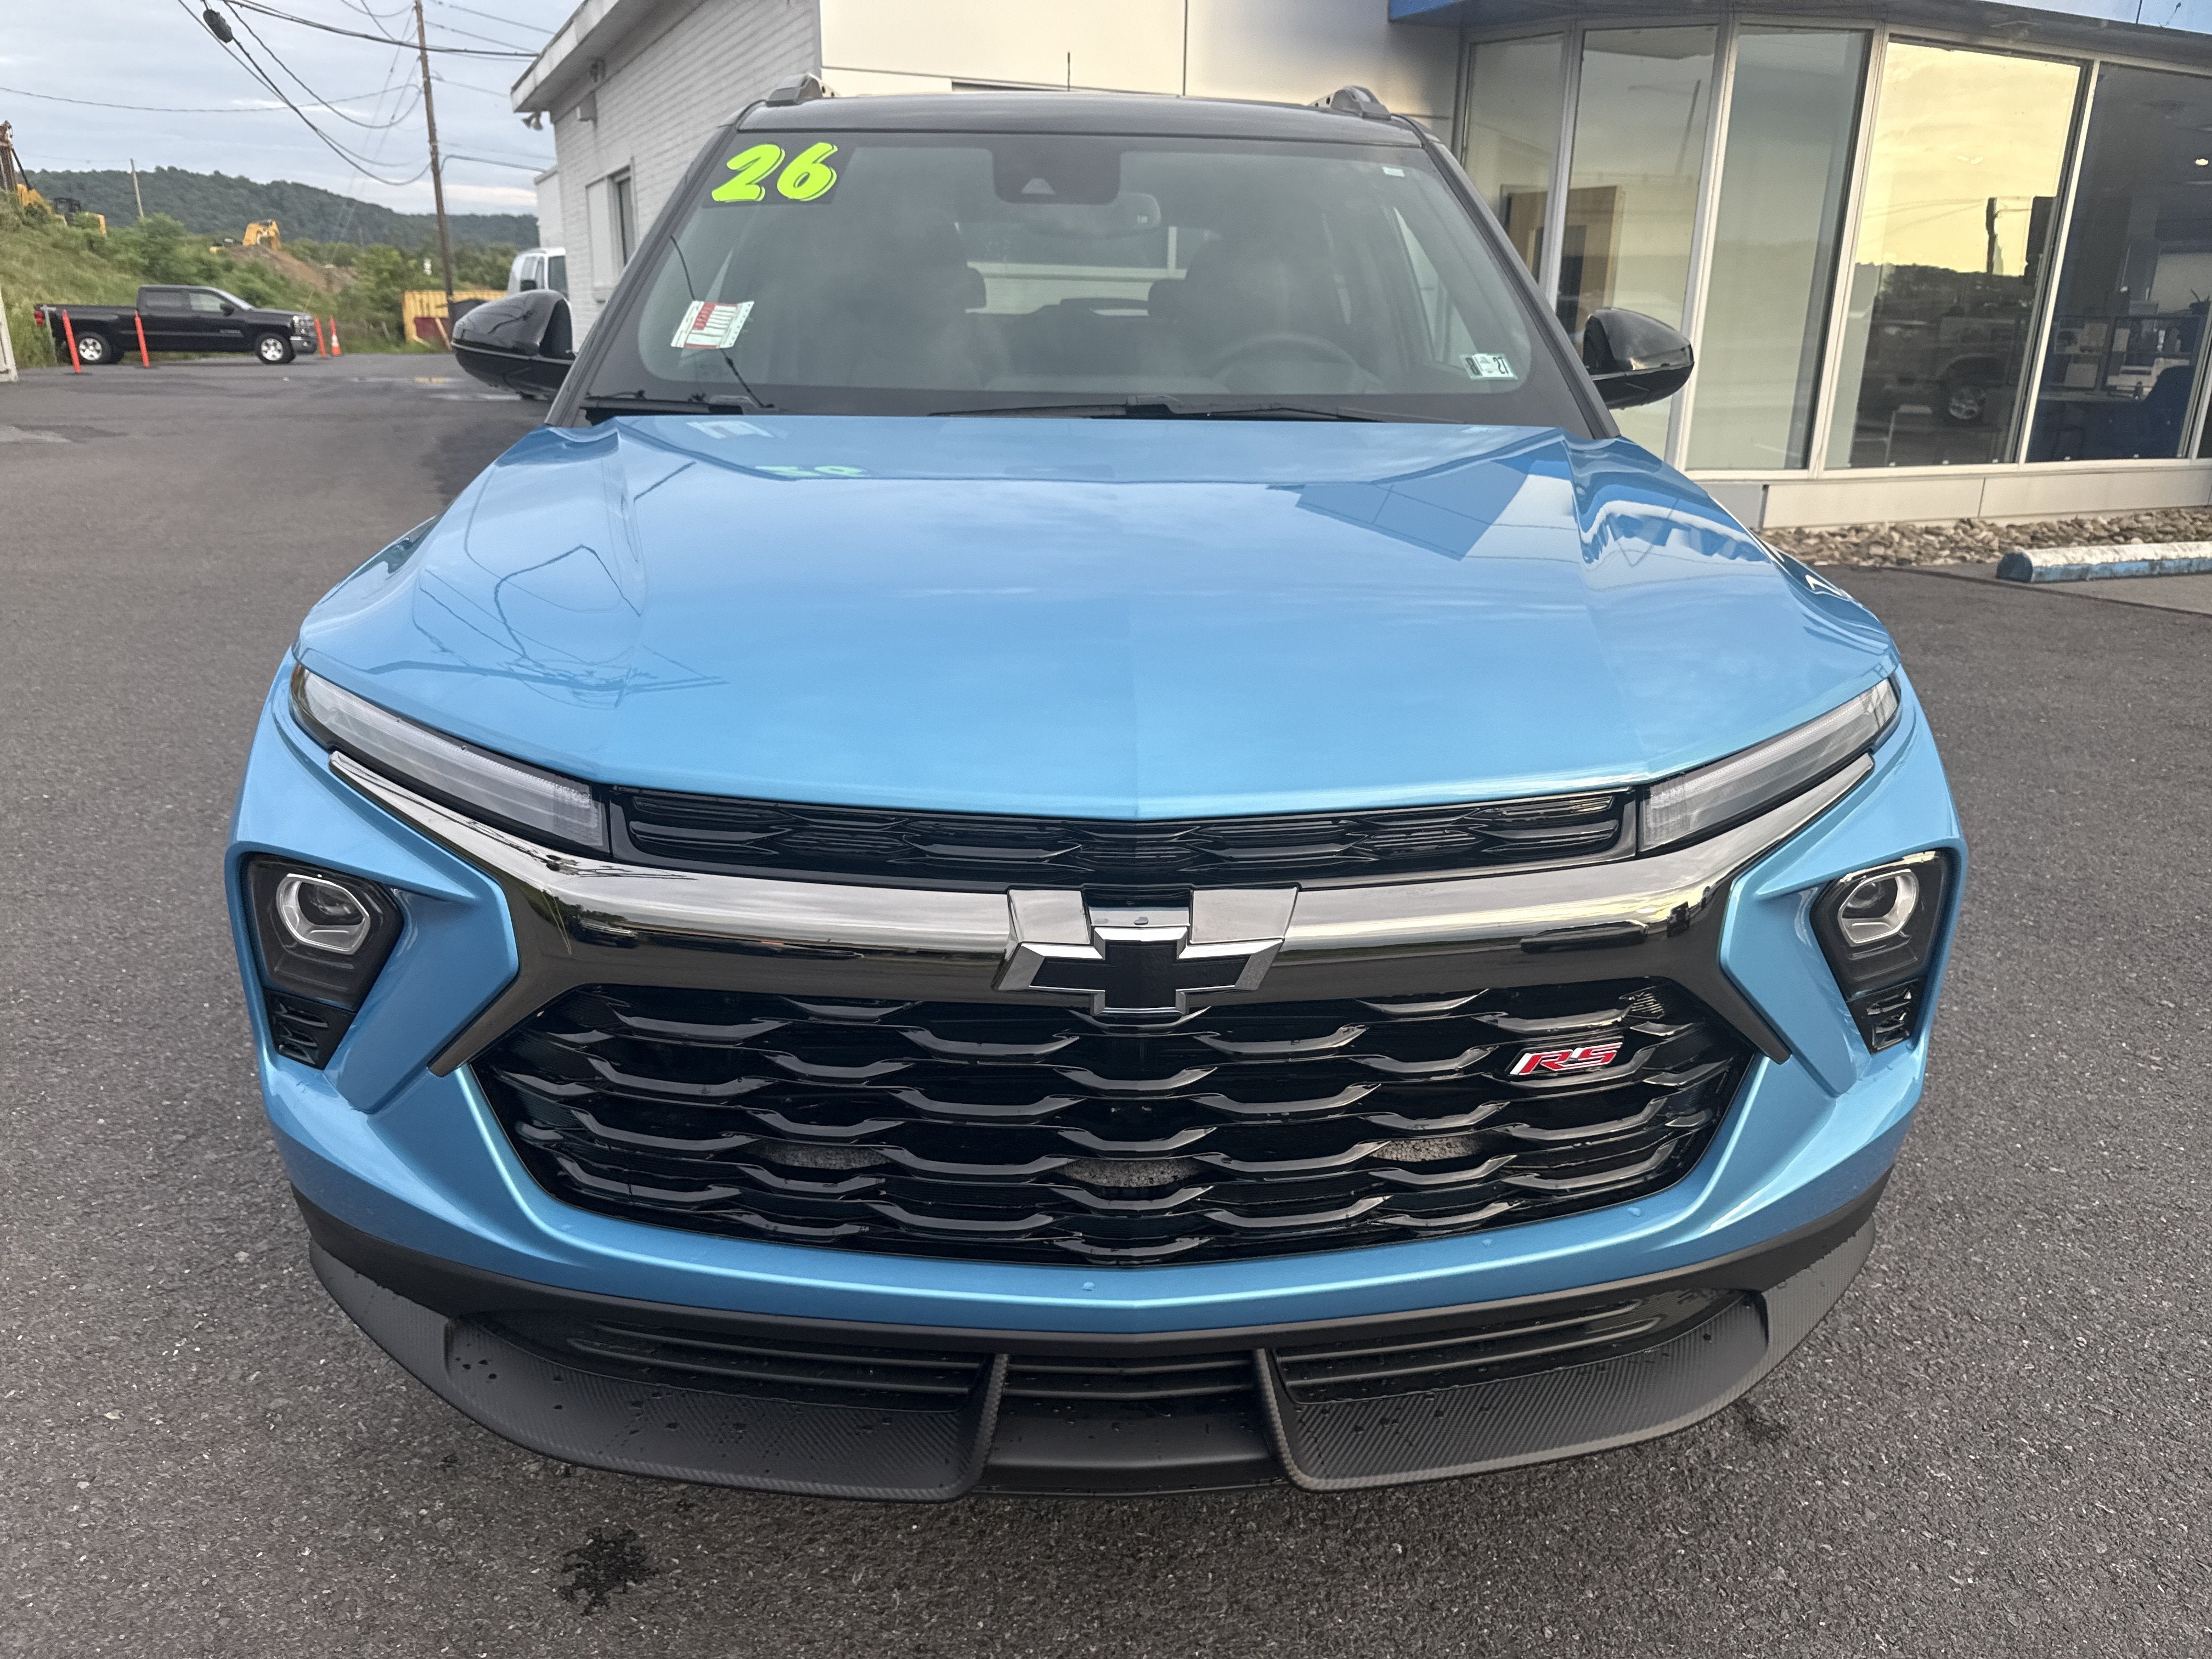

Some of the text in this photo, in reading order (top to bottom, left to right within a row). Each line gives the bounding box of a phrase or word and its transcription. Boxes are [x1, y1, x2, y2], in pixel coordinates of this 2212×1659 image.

[712, 142, 838, 202] 26
[1492, 357, 1509, 375] 27
[1509, 1042, 1623, 1075] RS
